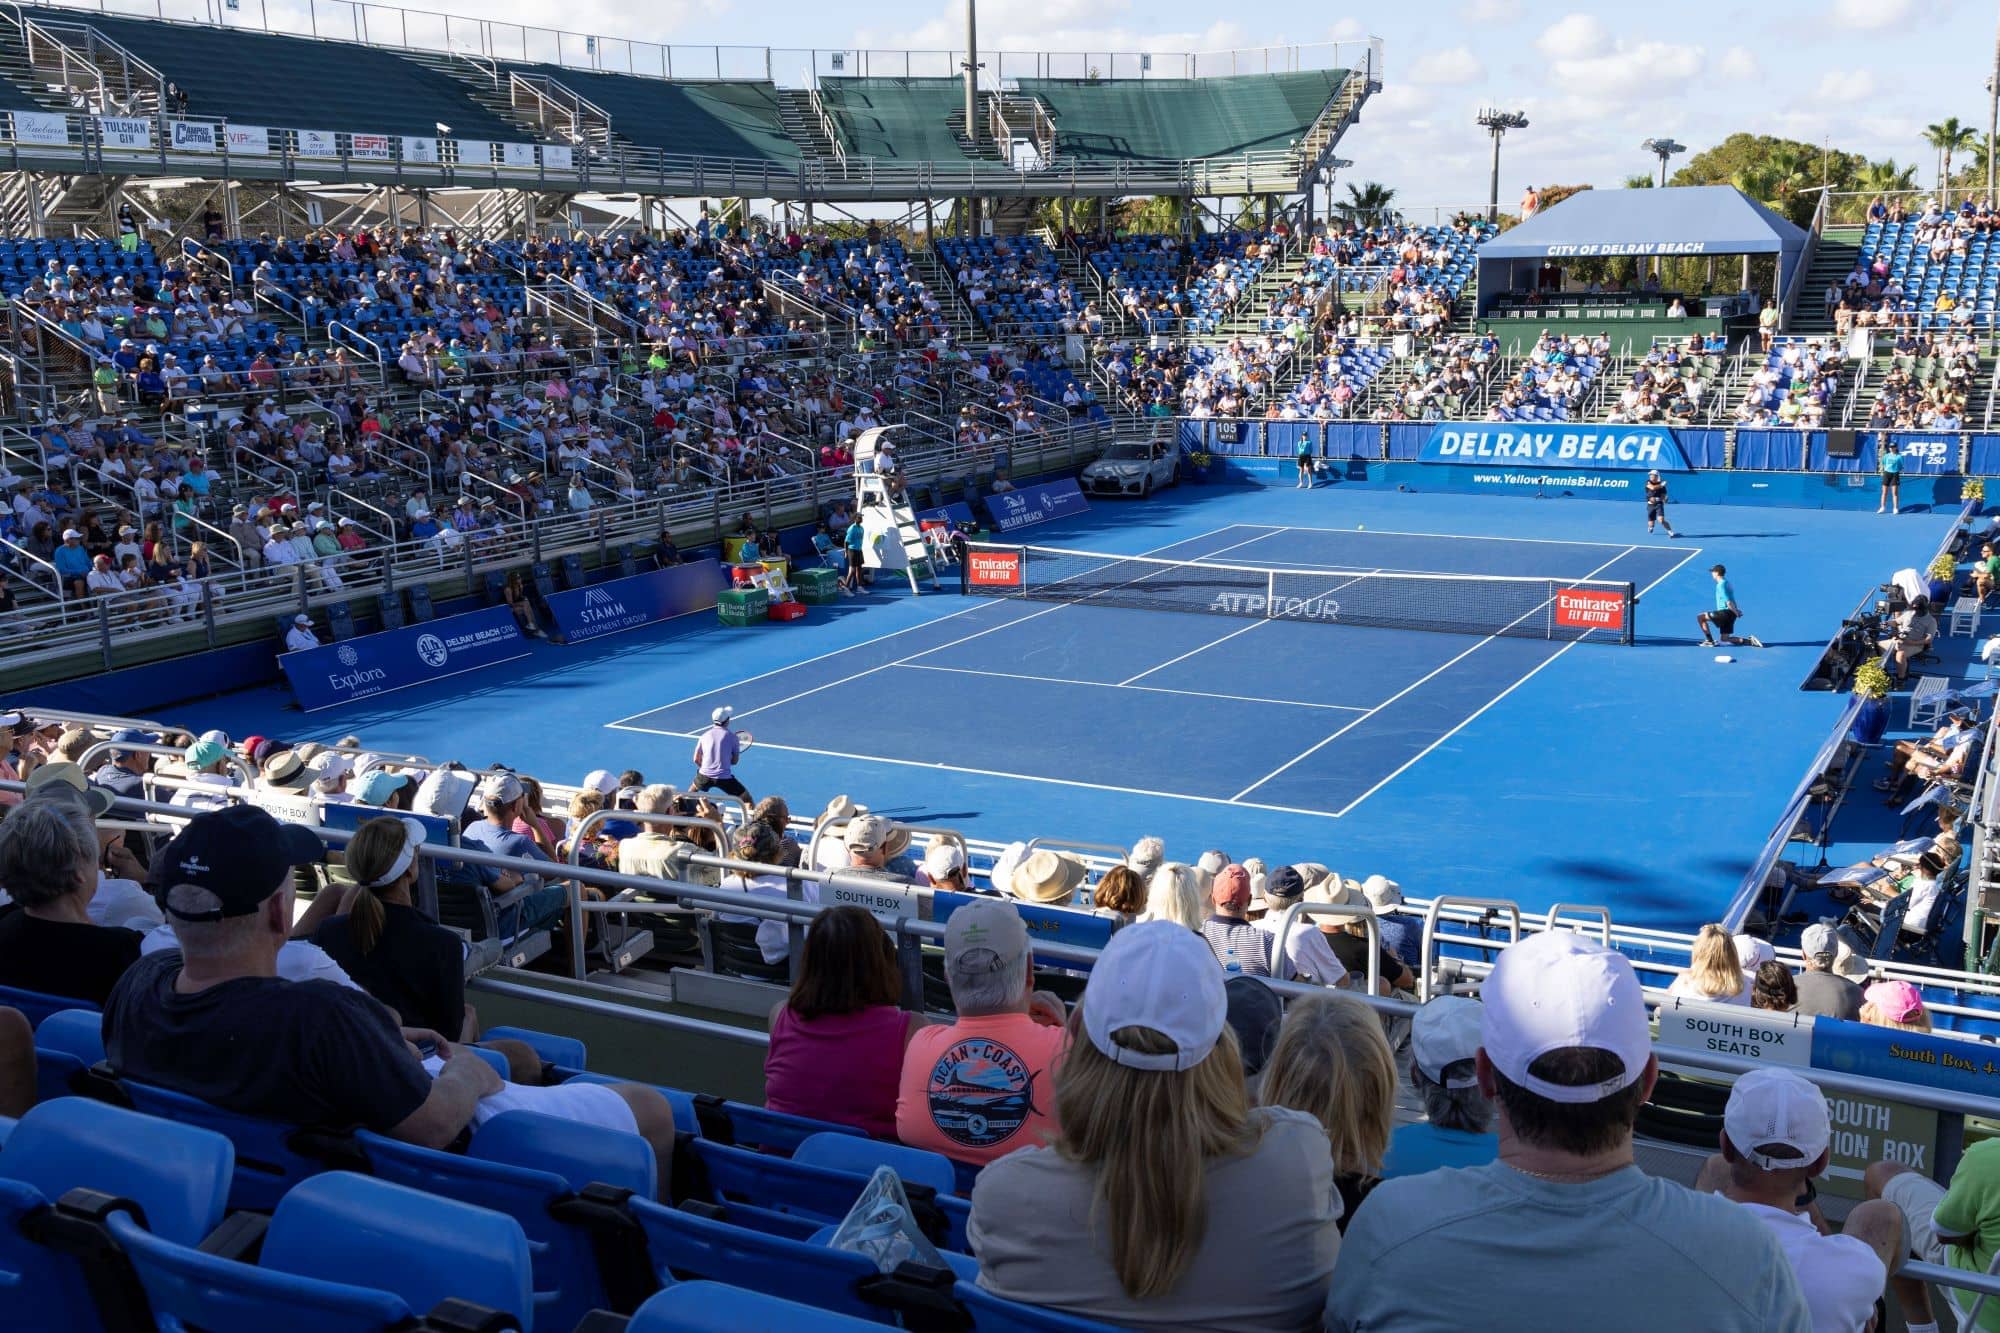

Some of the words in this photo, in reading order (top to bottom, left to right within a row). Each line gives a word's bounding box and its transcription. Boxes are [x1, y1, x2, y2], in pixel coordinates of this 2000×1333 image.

[104, 121, 146, 134] TULCHAN
[119, 134, 135, 144] GIN
[228, 132, 249, 145] VIP
[354, 136, 387, 149] ESPN
[1181, 218, 1191, 232] M
[1383, 210, 1393, 225] N
[983, 220, 990, 235] L
[1548, 244, 1578, 257] CITY
[1580, 244, 1599, 256] OF
[1600, 243, 1655, 256] DELRAY
[1657, 241, 1705, 254] BEACH
[1217, 422, 1237, 433] 105
[1439, 431, 1554, 458] DELRAY
[1558, 434, 1664, 461] BEACH
[1899, 442, 1948, 457] ATP
[1926, 456, 1947, 465] 250
[1473, 473, 1629, 489] www.YellowTennisBall.com
[1000, 515, 1024, 529] DELRAY
[1023, 510, 1044, 523] BEACH
[972, 557, 1018, 571] Emirates
[978, 570, 990, 581] FLY
[990, 570, 1010, 581] BETTER
[1209, 592, 1267, 614] ATP
[1271, 595, 1341, 620] TOUR
[1560, 596, 1621, 611] Emirates
[581, 602, 626, 623] STAMM
[1568, 611, 1580, 622] FLY
[1582, 612, 1609, 623] BETTER
[570, 619, 621, 639] DEVELOPMENT
[623, 613, 648, 626] GROUP
[446, 634, 474, 647] DELRAY
[474, 628, 500, 640] BEACH
[329, 668, 387, 691] Explora
[261, 803, 288, 816] SOUTH
[290, 808, 307, 818] BOX
[835, 890, 873, 905] SOUTH
[876, 897, 900, 910] BOX
[1685, 1018, 1742, 1038] SOUTH
[1749, 1028, 1785, 1045] BOX
[1706, 1037, 1761, 1058] SEATS
[935, 1045, 969, 1085] OCEAN
[983, 1044, 1025, 1084] COAST
[1889, 1043, 1936, 1065] South
[1941, 1052, 1978, 1073] Box,
[1983, 1061, 2000, 1076] 4-
[1825, 1097, 1891, 1131] SOUTH
[1831, 1130, 1869, 1160] ION
[1883, 1139, 1926, 1169] BOX
